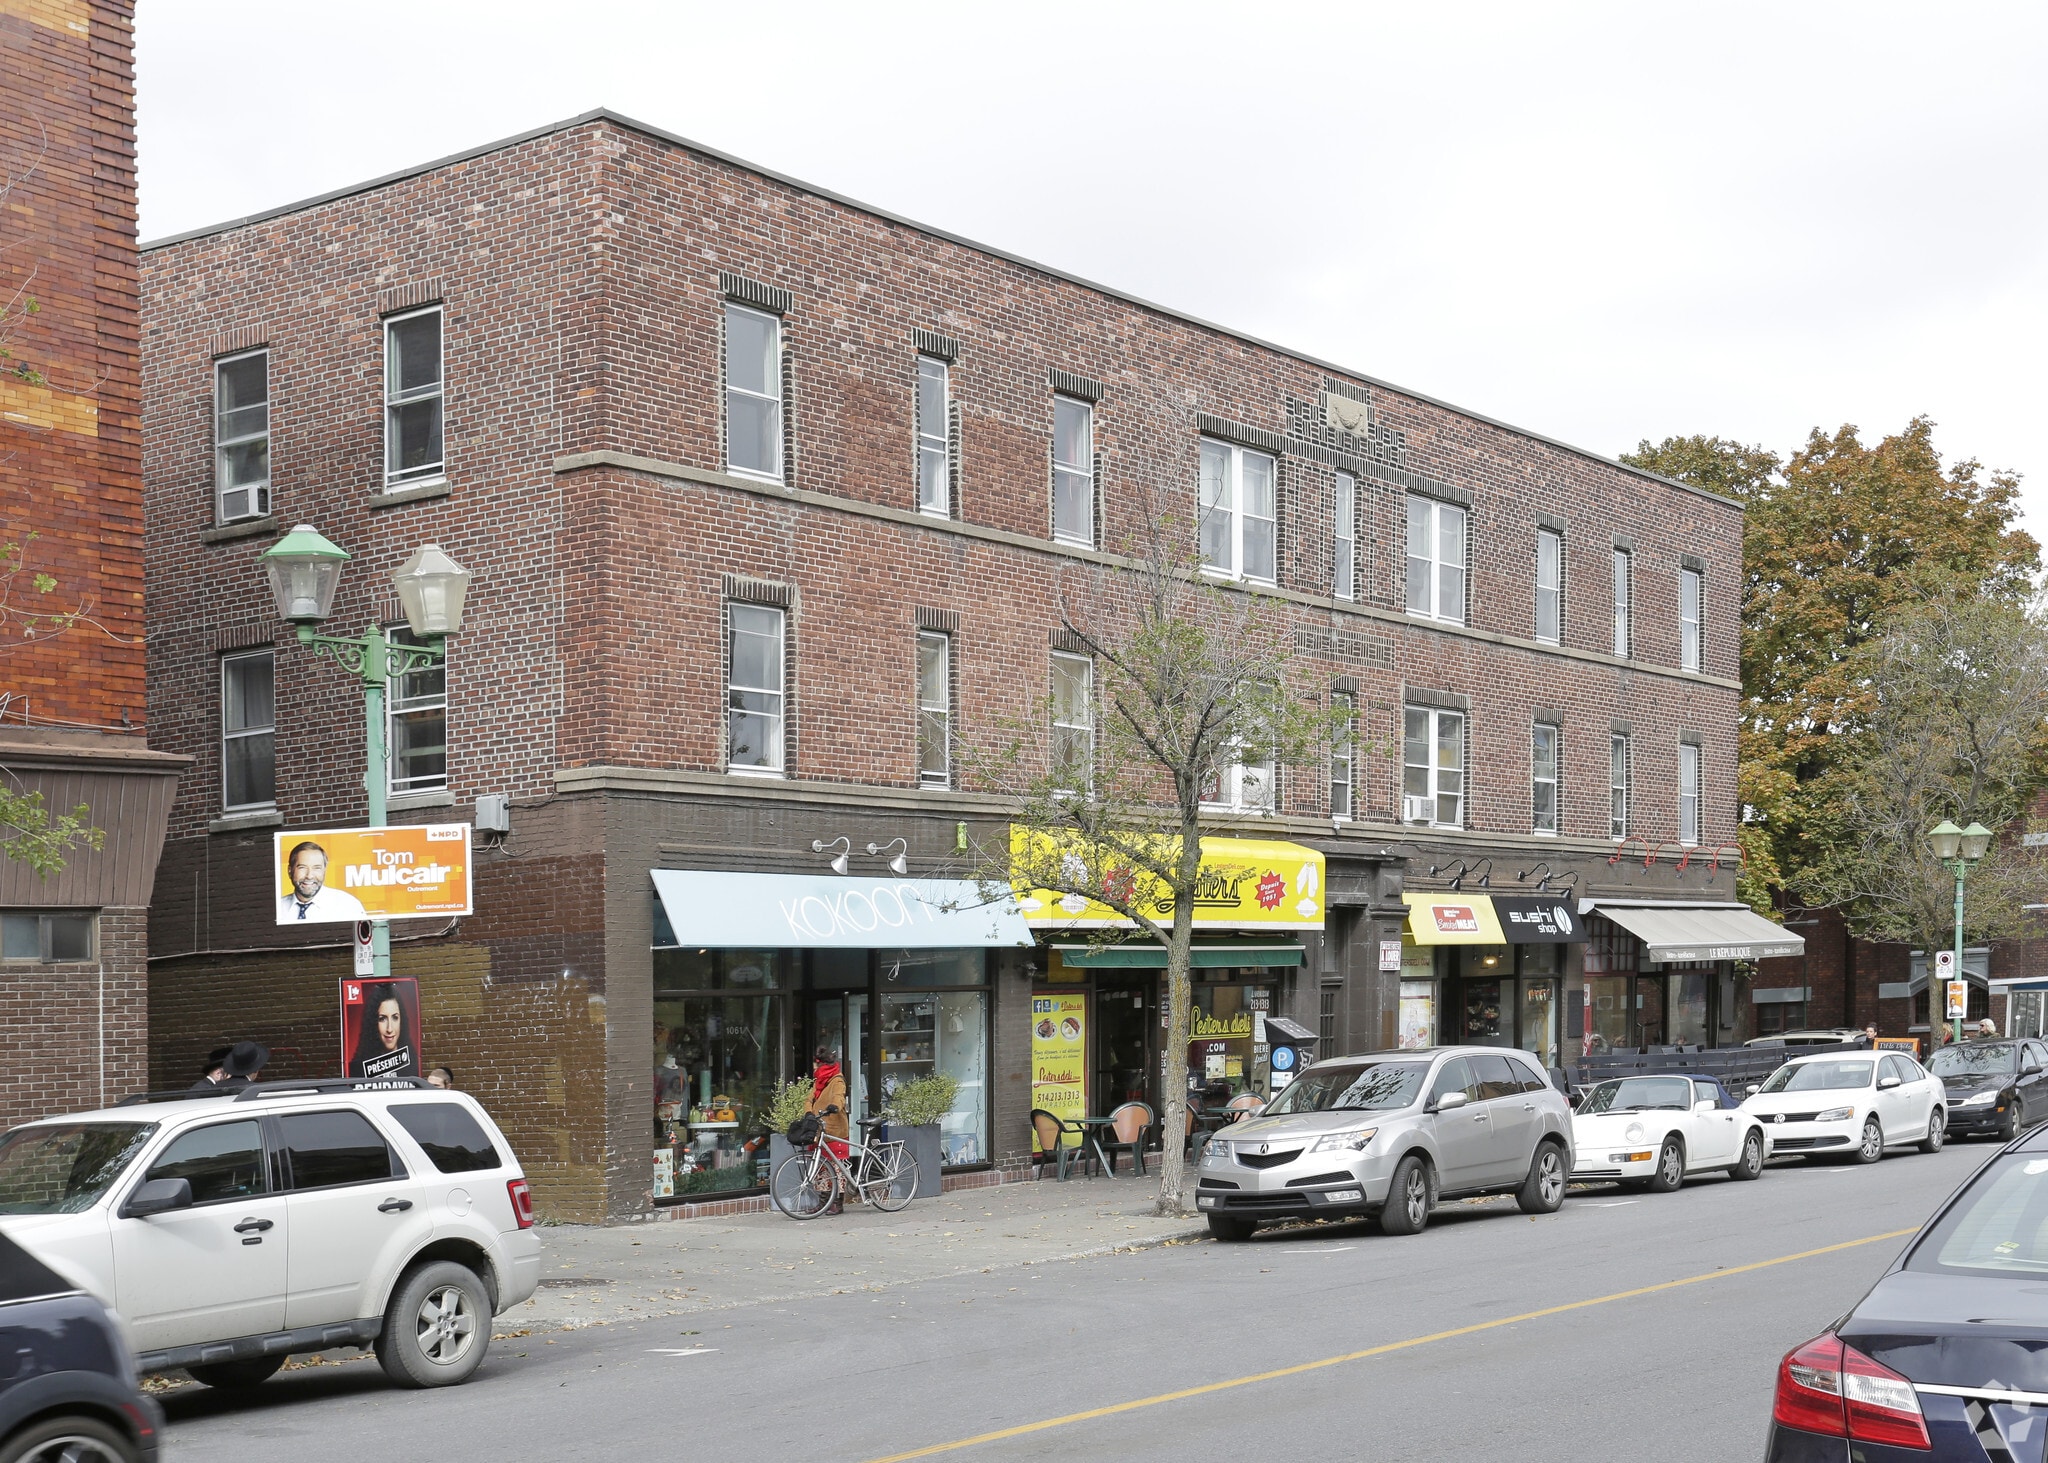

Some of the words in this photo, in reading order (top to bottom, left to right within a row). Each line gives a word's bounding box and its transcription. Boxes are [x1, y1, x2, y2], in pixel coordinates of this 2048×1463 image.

[372, 849, 414, 865] Tom
[345, 863, 451, 887] Mulcair
[1262, 893, 1277, 903] 1951
[1509, 905, 1553, 923] sushi
[1456, 919, 1476, 930] MEAT
[1538, 923, 1557, 935] shop
[1709, 948, 1717, 958] LE
[1250, 999, 1270, 1010] 213-1313
[1231, 1012, 1252, 1033] deli
[726, 1026, 743, 1035] 1061
[1206, 1042, 1226, 1053] .COM
[1036, 1090, 1080, 1103] 514.213.1313
